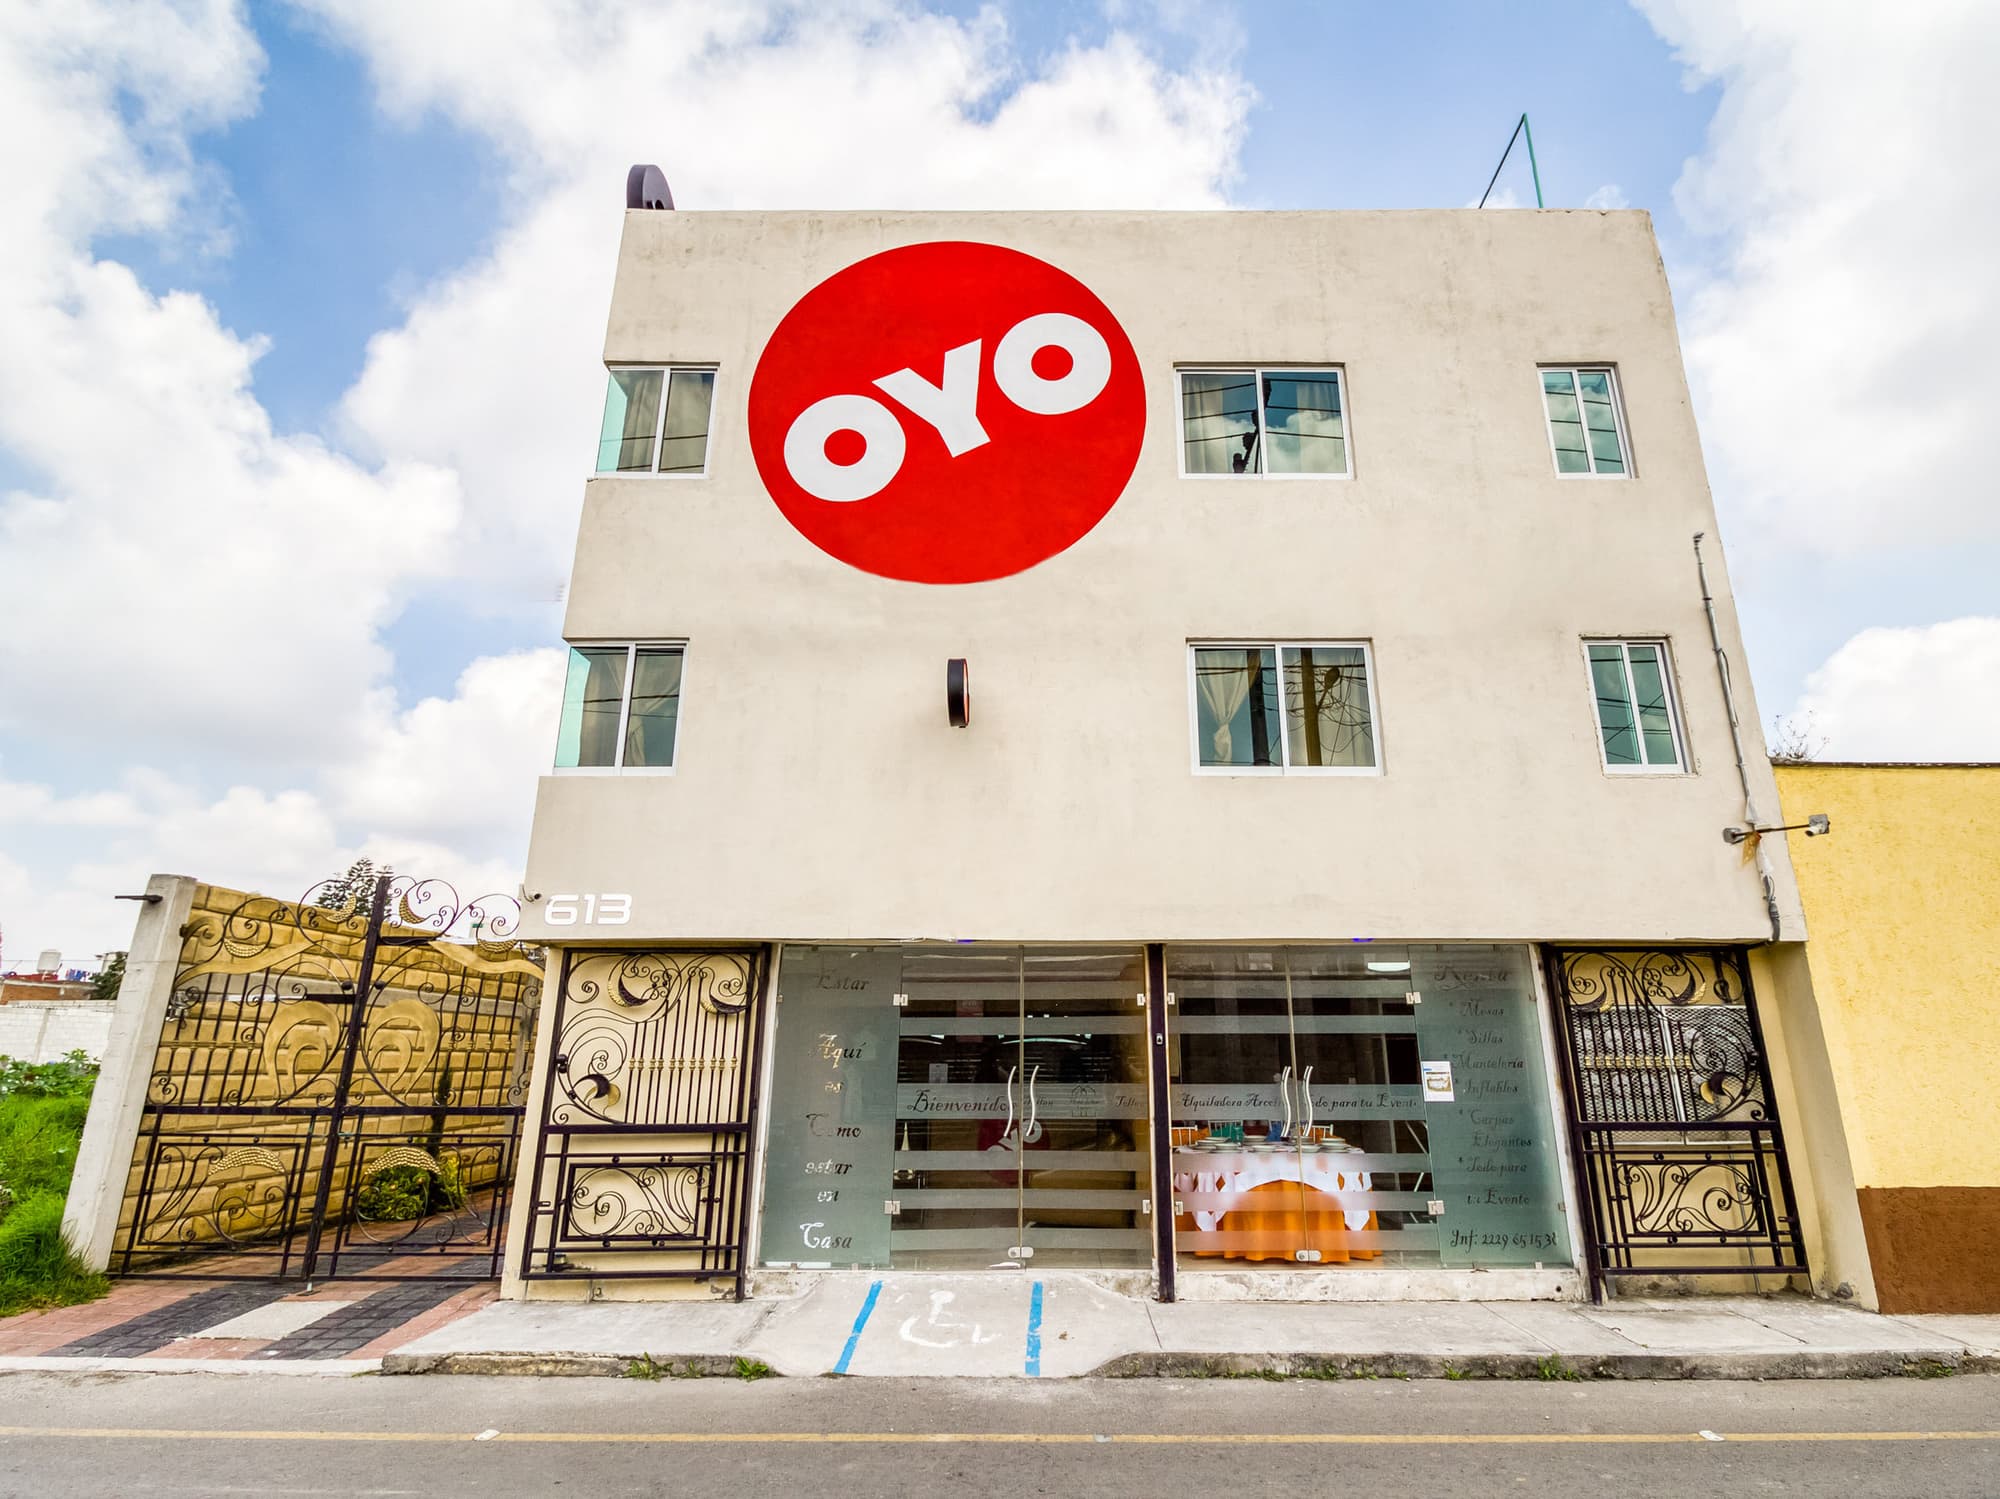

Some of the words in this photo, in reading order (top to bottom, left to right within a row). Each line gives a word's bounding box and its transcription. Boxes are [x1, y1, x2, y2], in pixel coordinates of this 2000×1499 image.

[783, 312, 1112, 503] OYO
[544, 893, 633, 925] 613
[805, 1112, 862, 1138] Cmo
[799, 1222, 853, 1248] Casa
